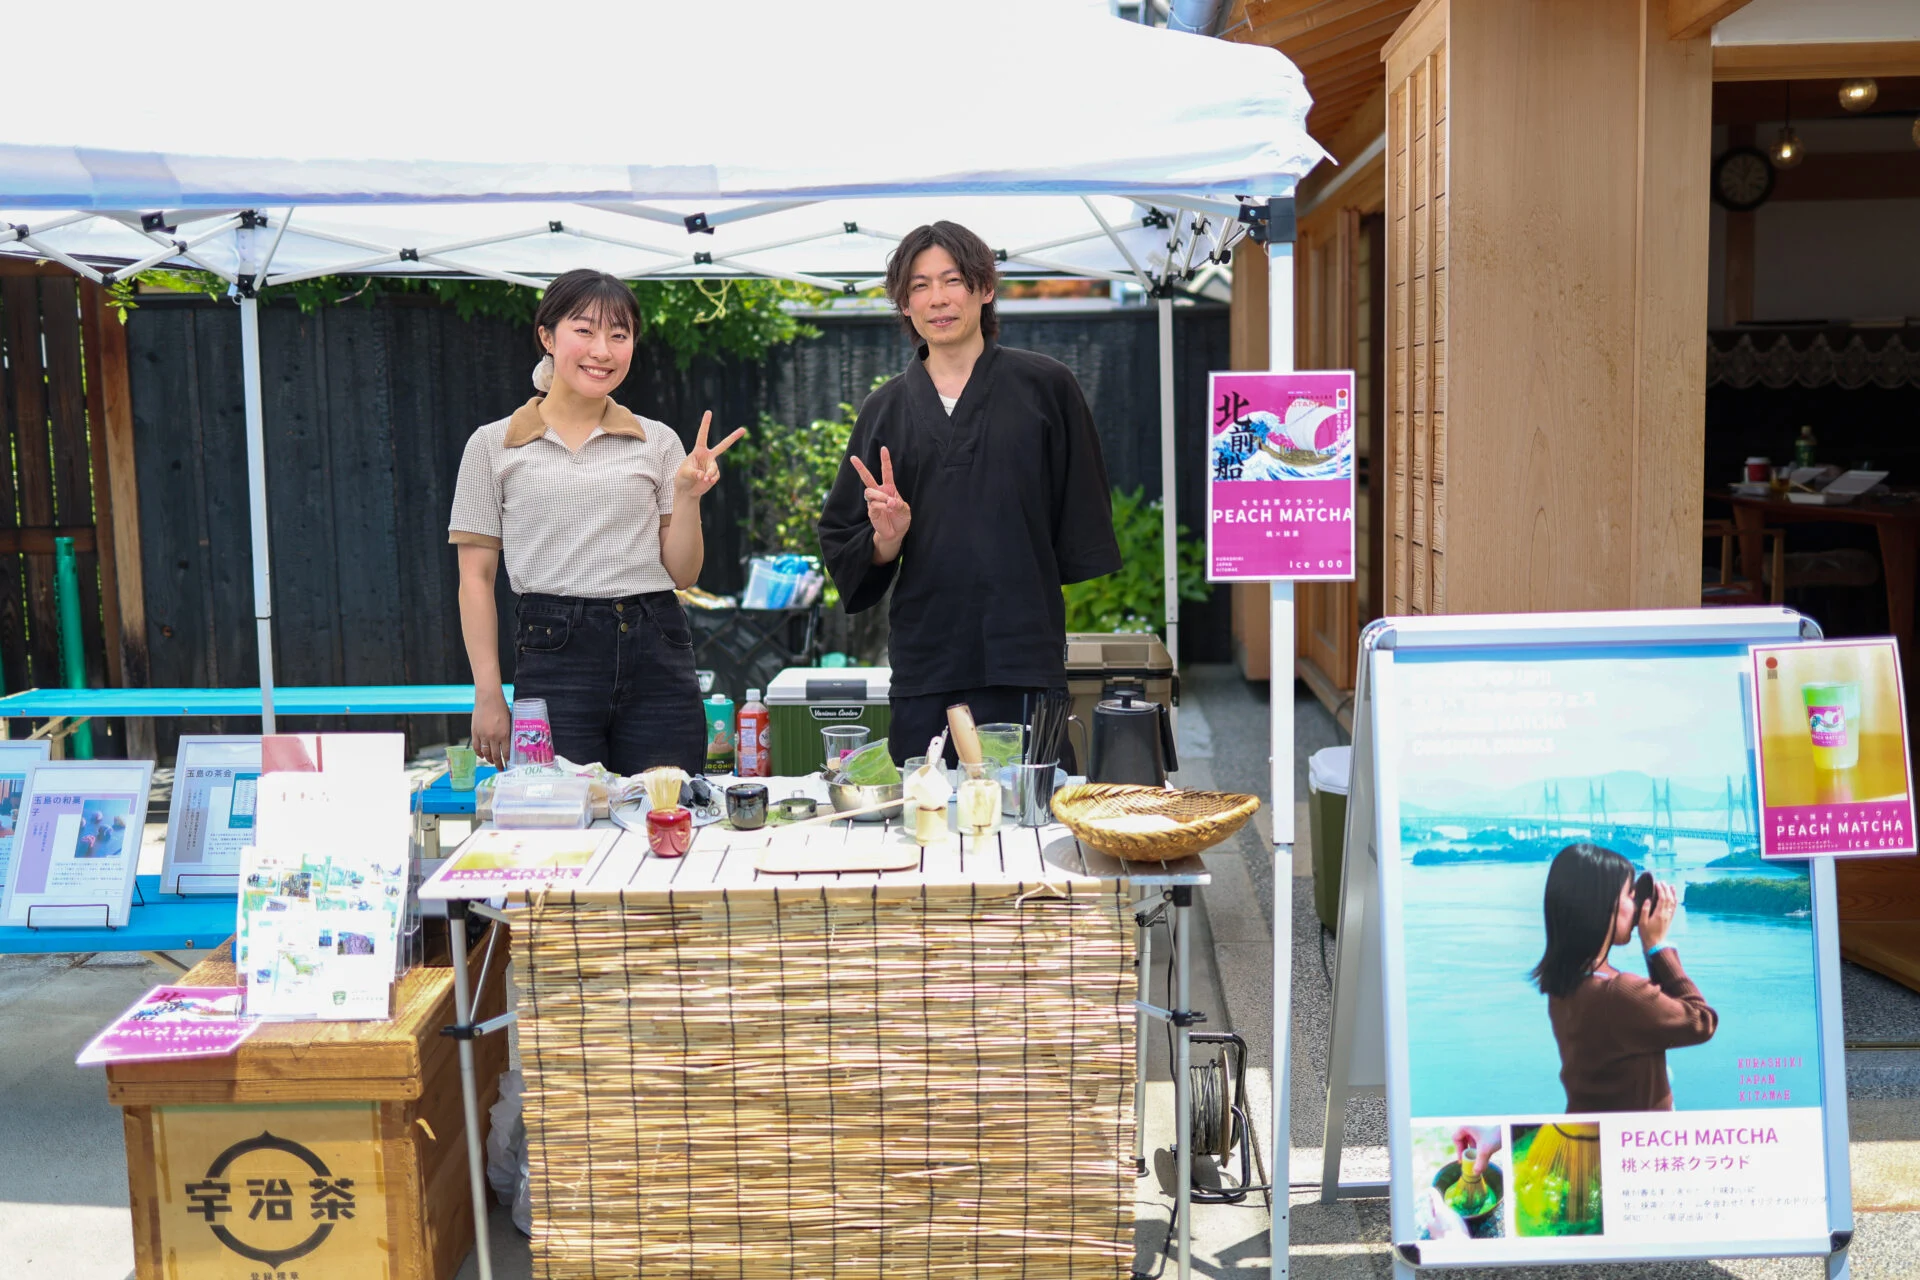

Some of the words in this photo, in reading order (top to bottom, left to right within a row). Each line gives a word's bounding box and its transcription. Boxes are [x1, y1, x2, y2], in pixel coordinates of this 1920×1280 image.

[1215, 391, 1257, 481] 北前船
[1213, 508, 1273, 523] PEACH
[1280, 507, 1351, 522] MATCHA
[1289, 560, 1310, 569] Ice
[1318, 559, 1343, 569] 600
[187, 769, 232, 778] 玉島の茶会
[1776, 823, 1830, 837] PEACH
[1838, 820, 1904, 834] MATCHA
[1848, 839, 1870, 849] Ice
[1879, 837, 1904, 846] 600
[1737, 1056, 1803, 1069] KURASHIKI
[1739, 1073, 1776, 1085] JAPAN
[1739, 1089, 1791, 1102] KITAMAE
[1621, 1130, 1688, 1147] PEACH
[1694, 1127, 1779, 1146] MATCHA
[1621, 1154, 1750, 1173] 桃×抹茶クラウド
[185, 1177, 357, 1222] 宇治茶
